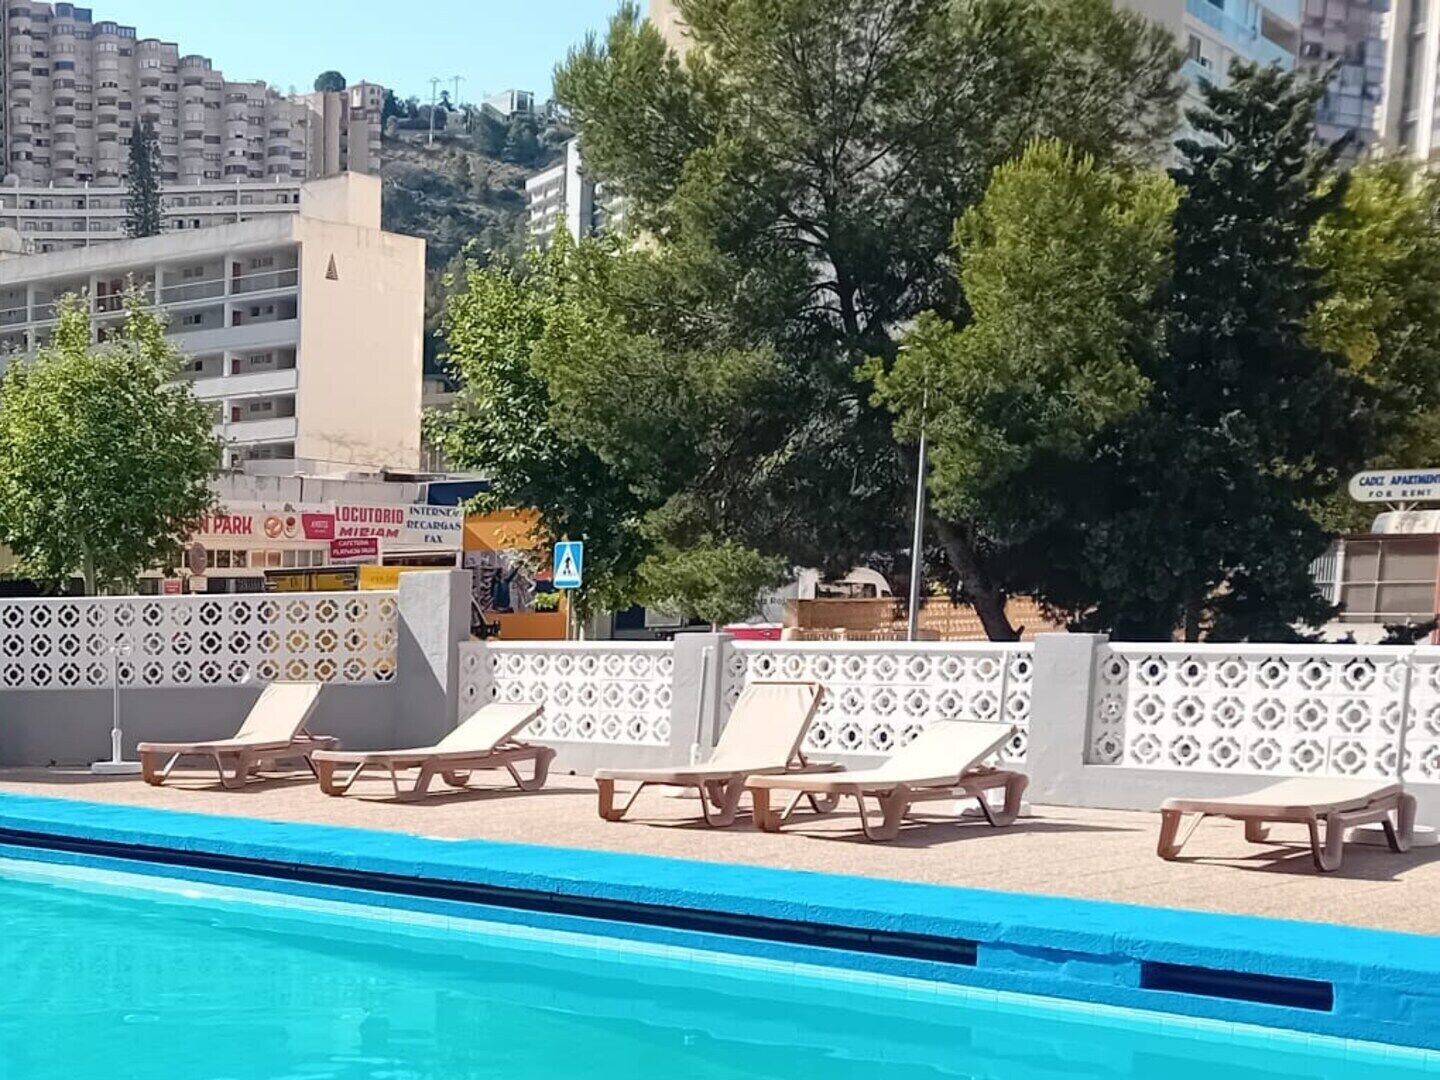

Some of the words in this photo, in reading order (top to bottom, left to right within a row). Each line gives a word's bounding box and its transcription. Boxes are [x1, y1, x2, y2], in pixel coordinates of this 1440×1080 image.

[335, 506, 404, 525] LOCUTORIO
[409, 506, 460, 518] INTERNE
[213, 514, 253, 535] PARK
[406, 520, 462, 532] RECARGAS
[339, 526, 400, 539] MIRIAM
[423, 534, 443, 544] FAX
